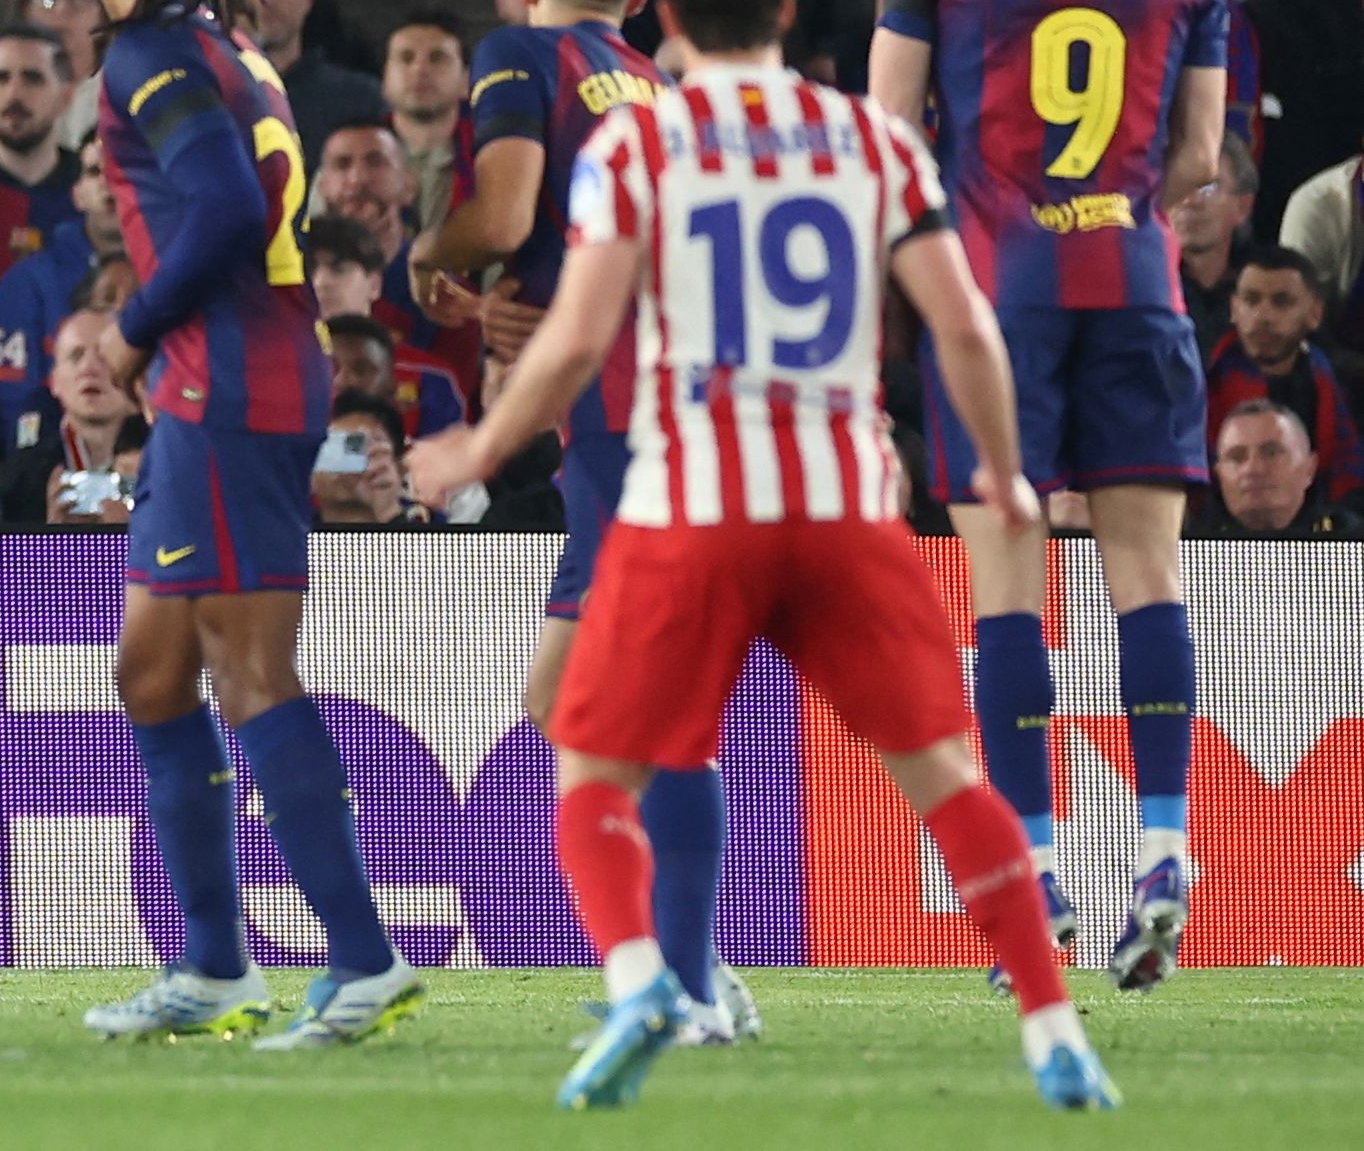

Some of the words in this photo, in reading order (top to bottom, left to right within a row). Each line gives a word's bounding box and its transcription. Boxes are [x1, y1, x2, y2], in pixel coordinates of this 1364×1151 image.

[1029, 6, 1128, 180] 9
[252, 116, 310, 286] 2
[687, 194, 859, 372] 19
